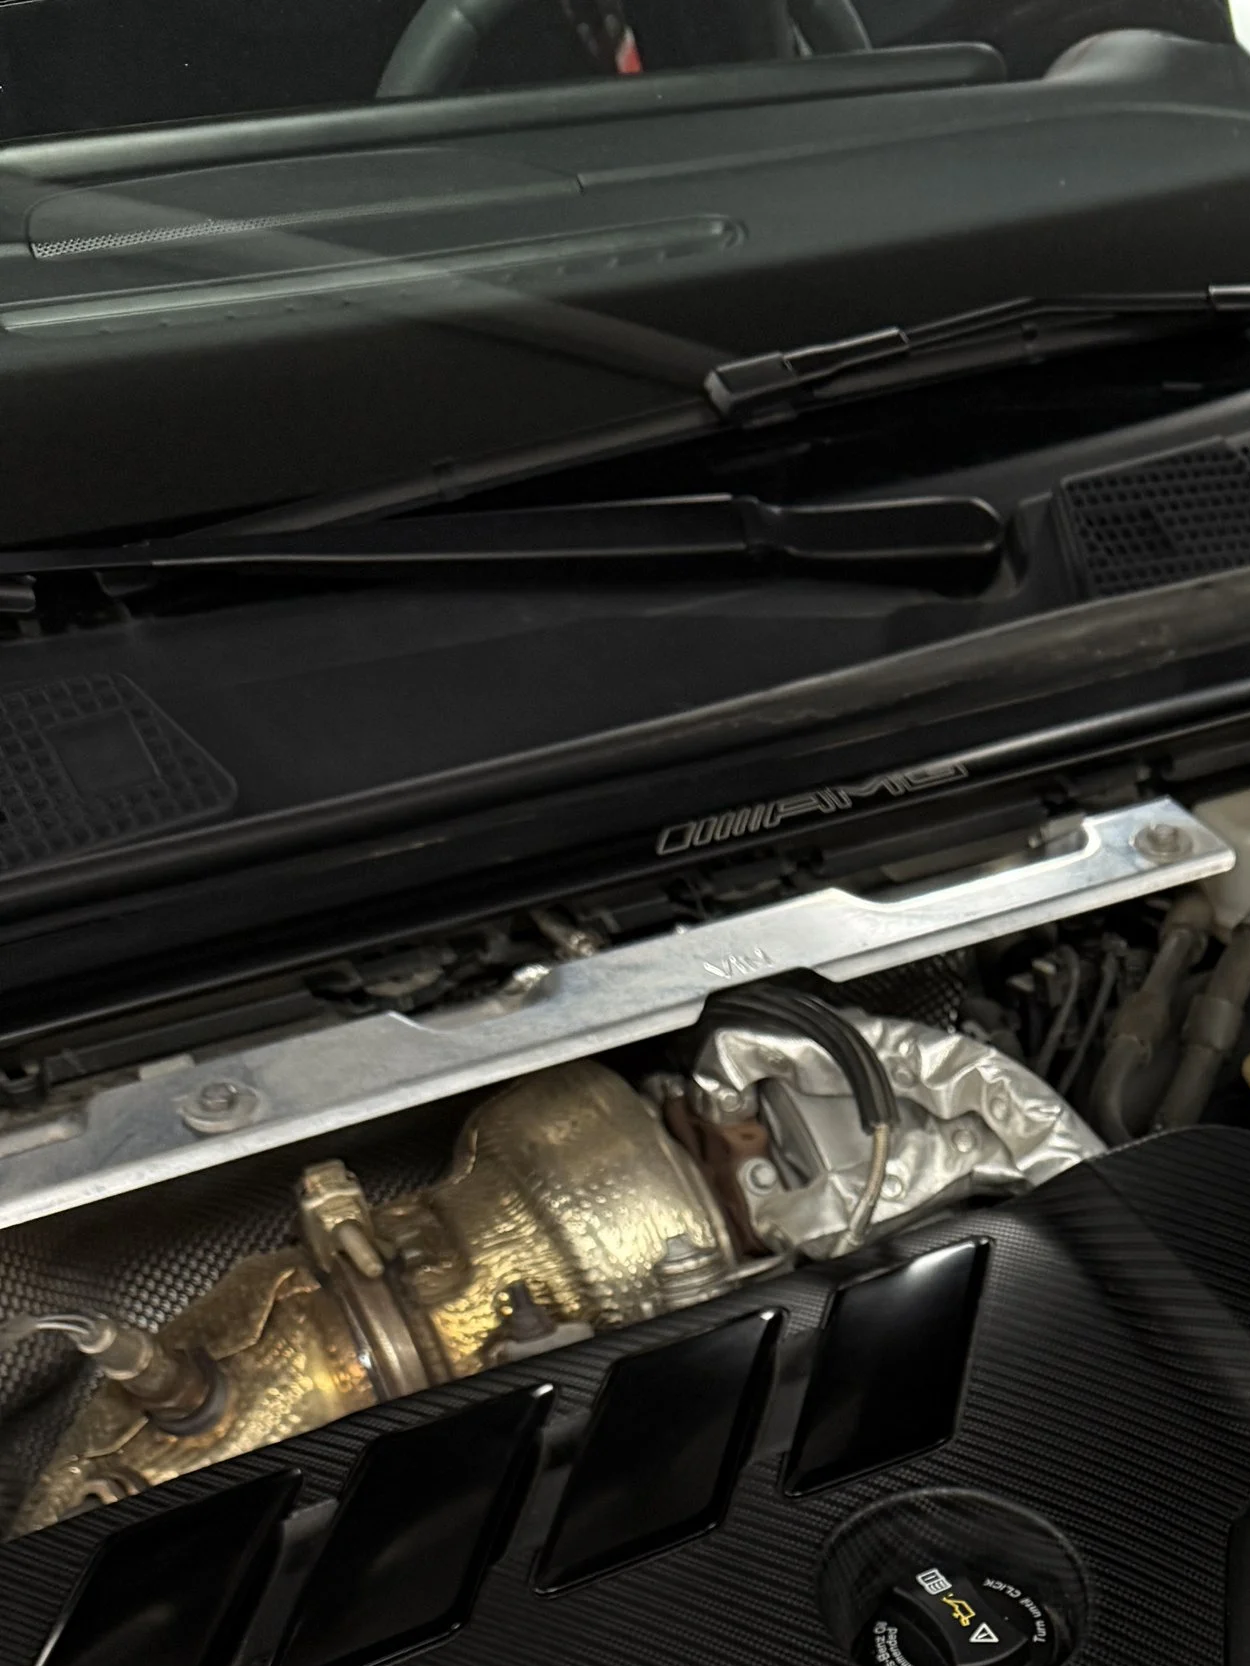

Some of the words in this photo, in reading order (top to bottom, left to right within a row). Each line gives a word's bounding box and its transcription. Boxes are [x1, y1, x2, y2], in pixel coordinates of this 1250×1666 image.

[983, 1578, 1022, 1598] CLICK
[1019, 1597, 1042, 1618] until
[1032, 1620, 1047, 1643] Turn
